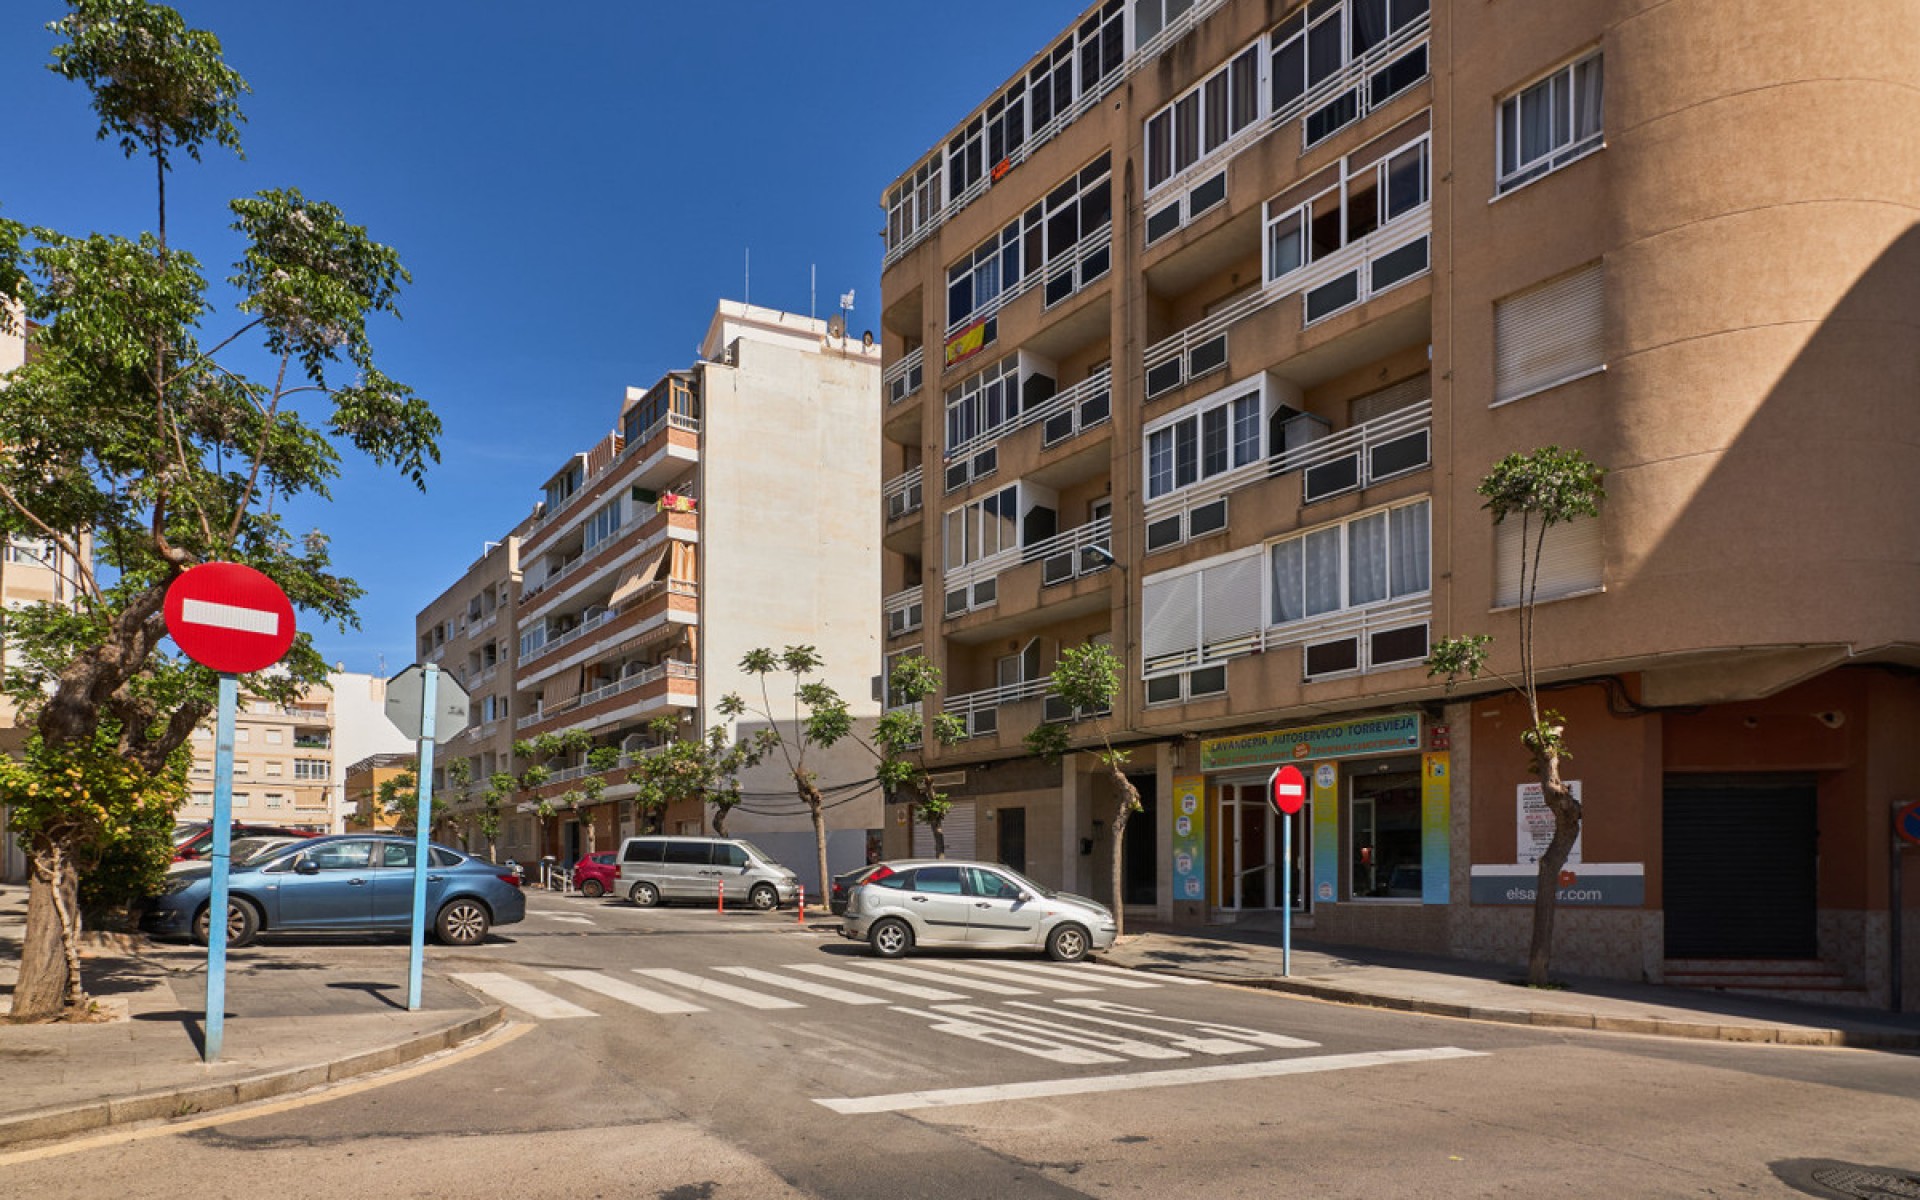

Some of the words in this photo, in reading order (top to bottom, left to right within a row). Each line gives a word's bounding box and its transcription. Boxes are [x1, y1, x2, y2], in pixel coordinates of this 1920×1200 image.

[1211, 736, 1268, 752] LAVANDERIA
[1272, 727, 1343, 745] AUTOSERVICIO
[1347, 718, 1414, 736] TORREVIEJA
[1506, 887, 1602, 900] elsar.com
[888, 999, 1322, 1064] STOP
